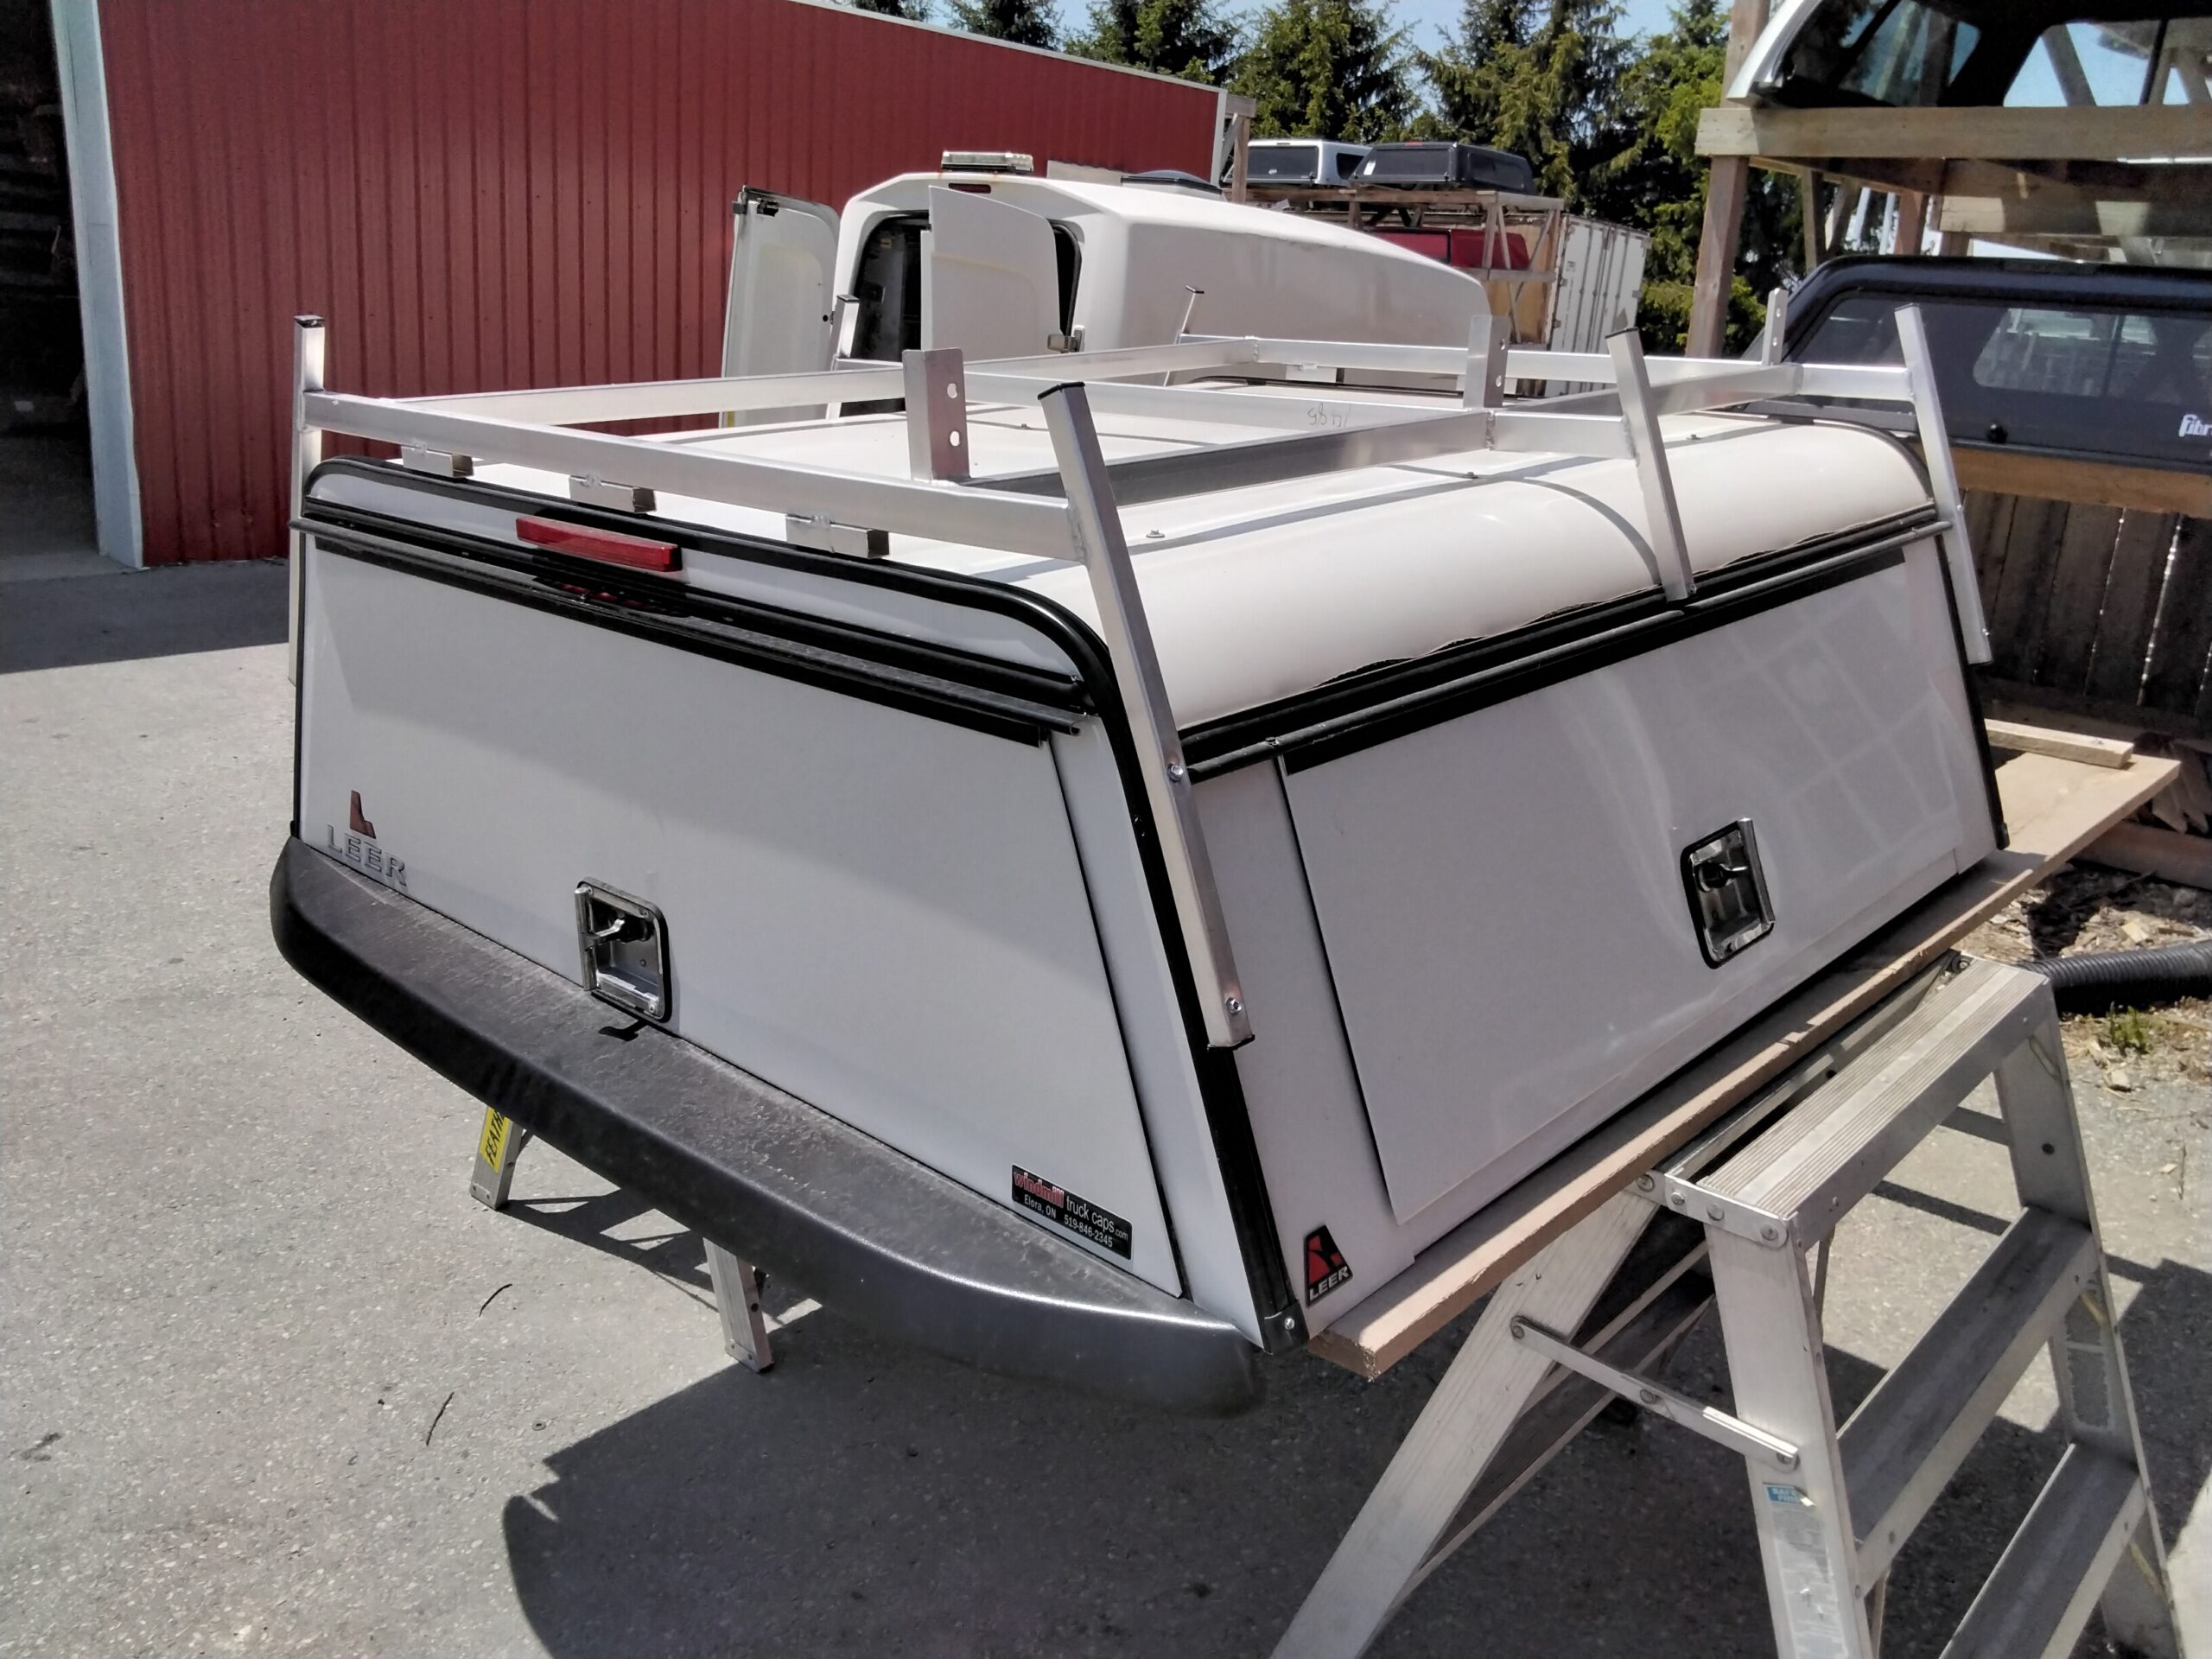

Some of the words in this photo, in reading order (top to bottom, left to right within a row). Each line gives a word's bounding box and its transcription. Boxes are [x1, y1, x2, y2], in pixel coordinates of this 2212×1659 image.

[327, 823, 407, 887] LEER
[1014, 1172, 1065, 1209] windmill
[1066, 1195, 1090, 1221] truck
[1024, 1193, 1044, 1213] Elora,
[1046, 1205, 1057, 1219] ON
[1064, 1214, 1113, 1248] 519-846-2345
[1309, 1266, 1350, 1301] LEER
